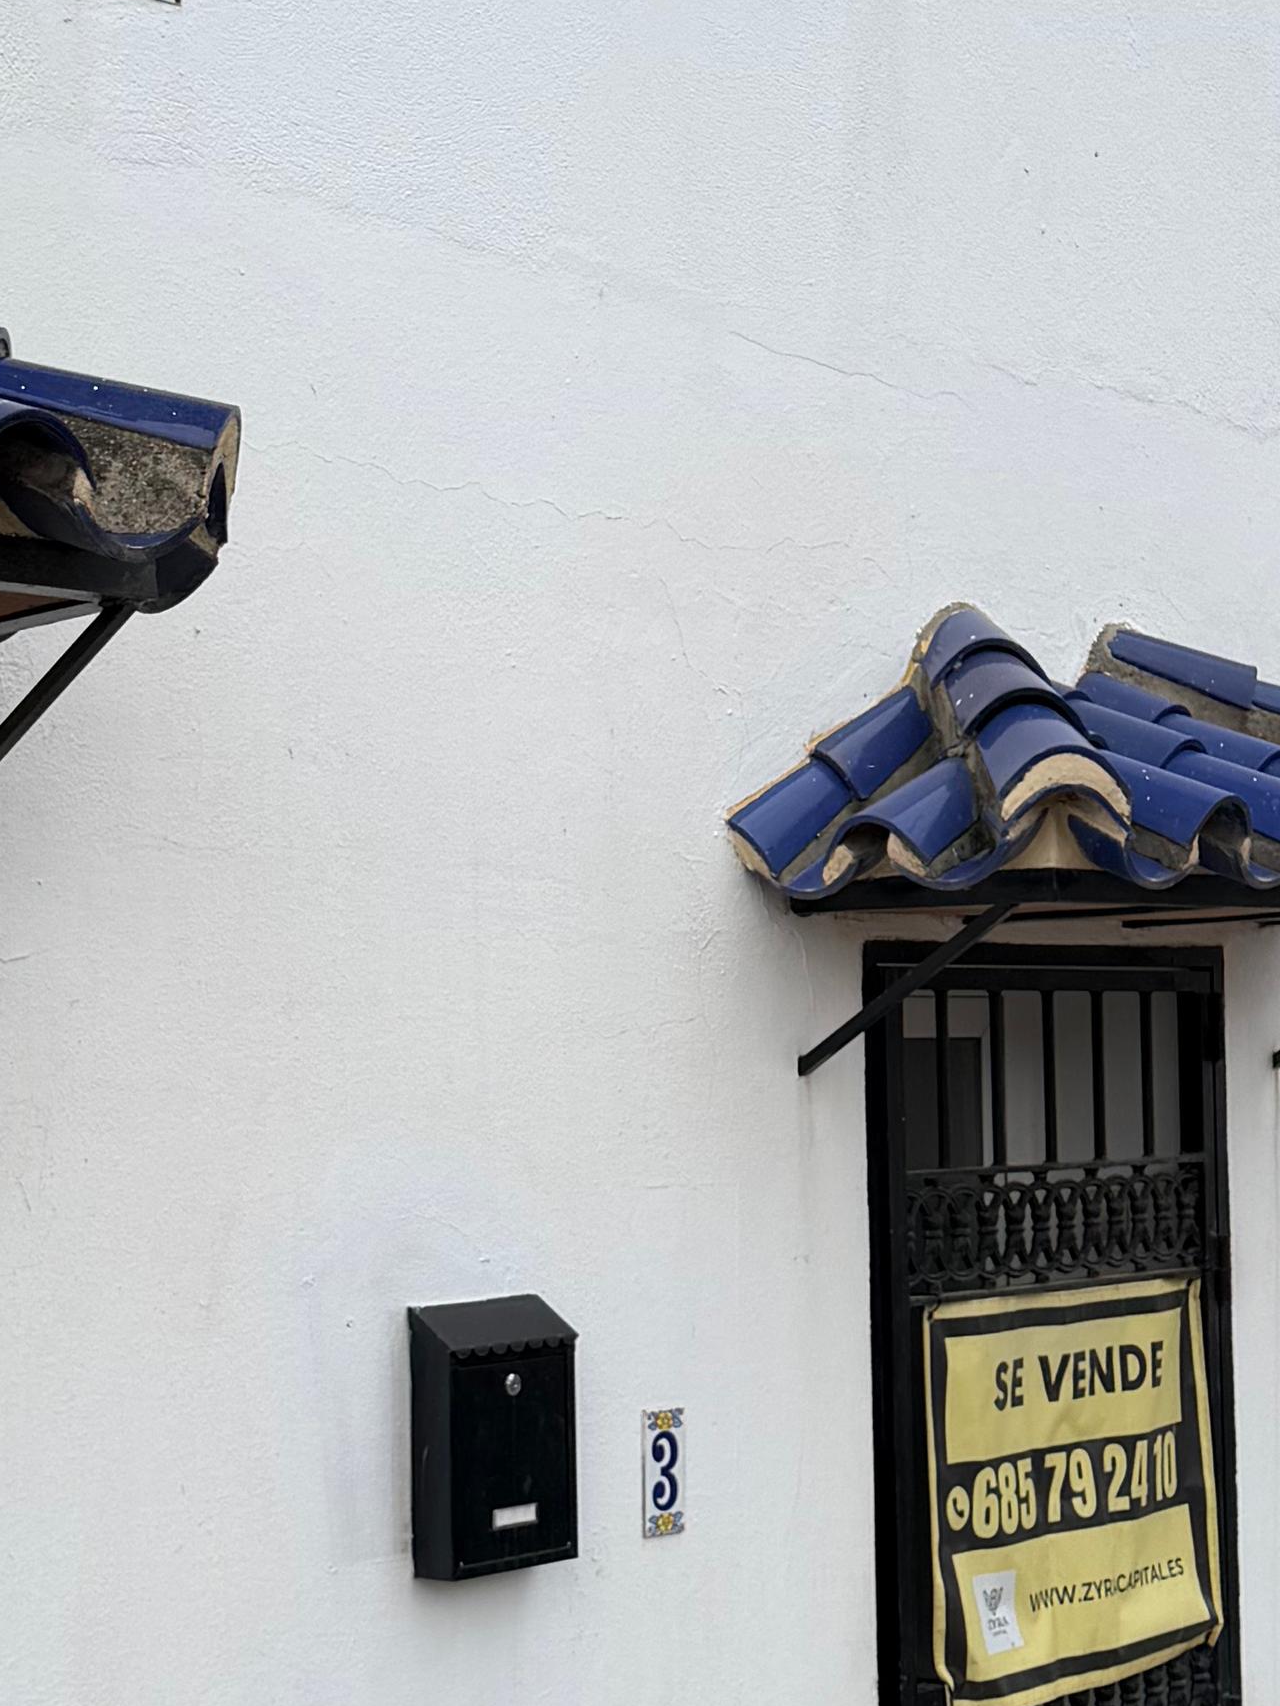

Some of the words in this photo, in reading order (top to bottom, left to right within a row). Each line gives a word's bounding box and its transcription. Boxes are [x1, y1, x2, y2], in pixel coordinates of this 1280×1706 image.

[993, 1357, 1024, 1411] SE
[1038, 1340, 1164, 1403] VENDE
[651, 1430, 679, 1512] 3
[972, 1456, 1037, 1539] 685
[1044, 1447, 1097, 1524] 79
